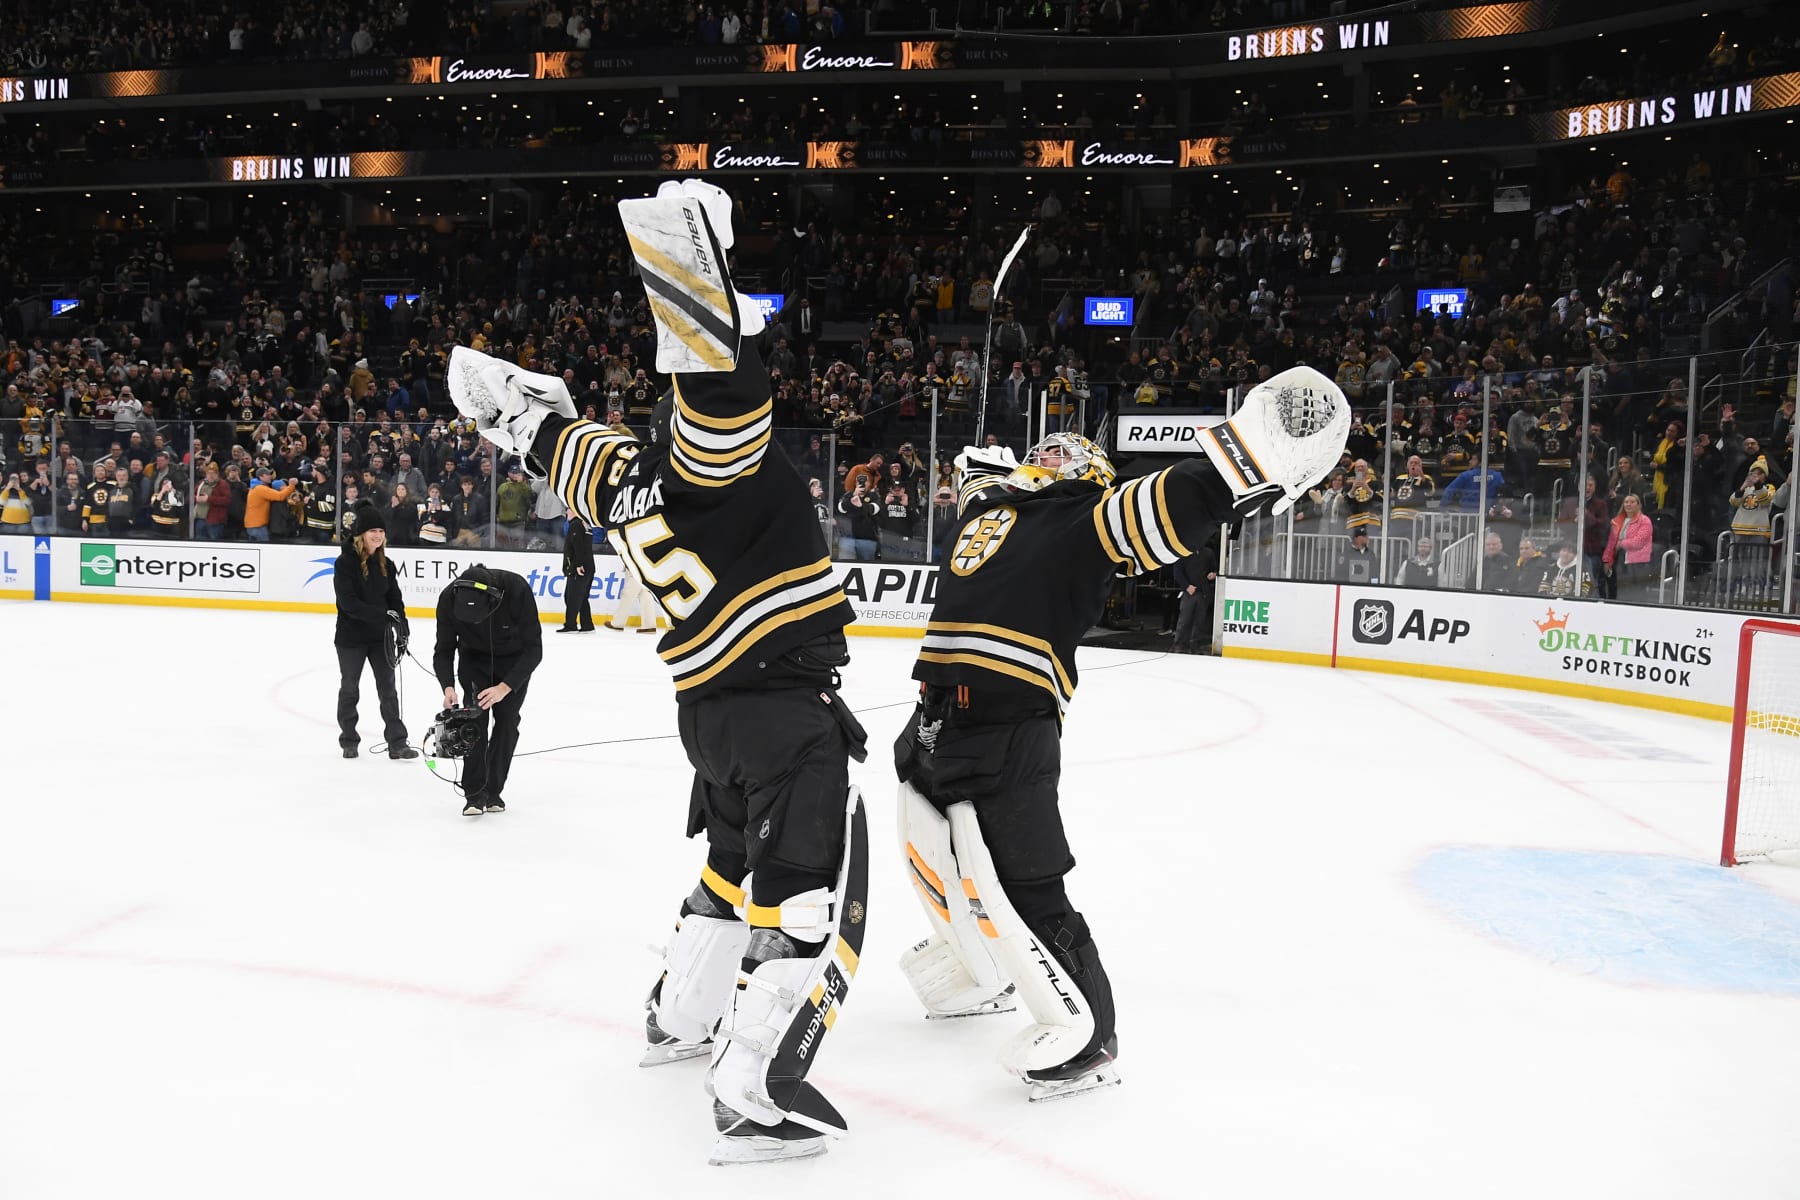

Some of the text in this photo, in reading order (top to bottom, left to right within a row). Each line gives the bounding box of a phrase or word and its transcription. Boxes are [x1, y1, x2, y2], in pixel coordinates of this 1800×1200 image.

[1227, 20, 1389, 61] BRUINS WIN
[446, 58, 530, 82] Encore
[802, 45, 894, 70] Encore
[2, 77, 69, 102] NS WIN
[1568, 84, 1752, 138] BRUINS WIN
[713, 145, 800, 169] Encore
[1081, 141, 1175, 166] Encore
[232, 156, 350, 181] BRUINS WIN
[1096, 302, 1122, 312] BUD
[1430, 293, 1459, 305] BUD
[1091, 310, 1126, 321] LIGHT
[1127, 425, 1207, 442] RAPID
[1219, 427, 1260, 485] TRUE
[86, 553, 256, 583] enterprise
[395, 560, 463, 579] METR
[854, 609, 931, 621] CYBERSECURI
[1695, 628, 1715, 639] 21+
[1538, 628, 1712, 666] DRAFTKINGS
[1562, 655, 1692, 687] SPORTSBOOK
[1030, 937, 1081, 1016] TRUE
